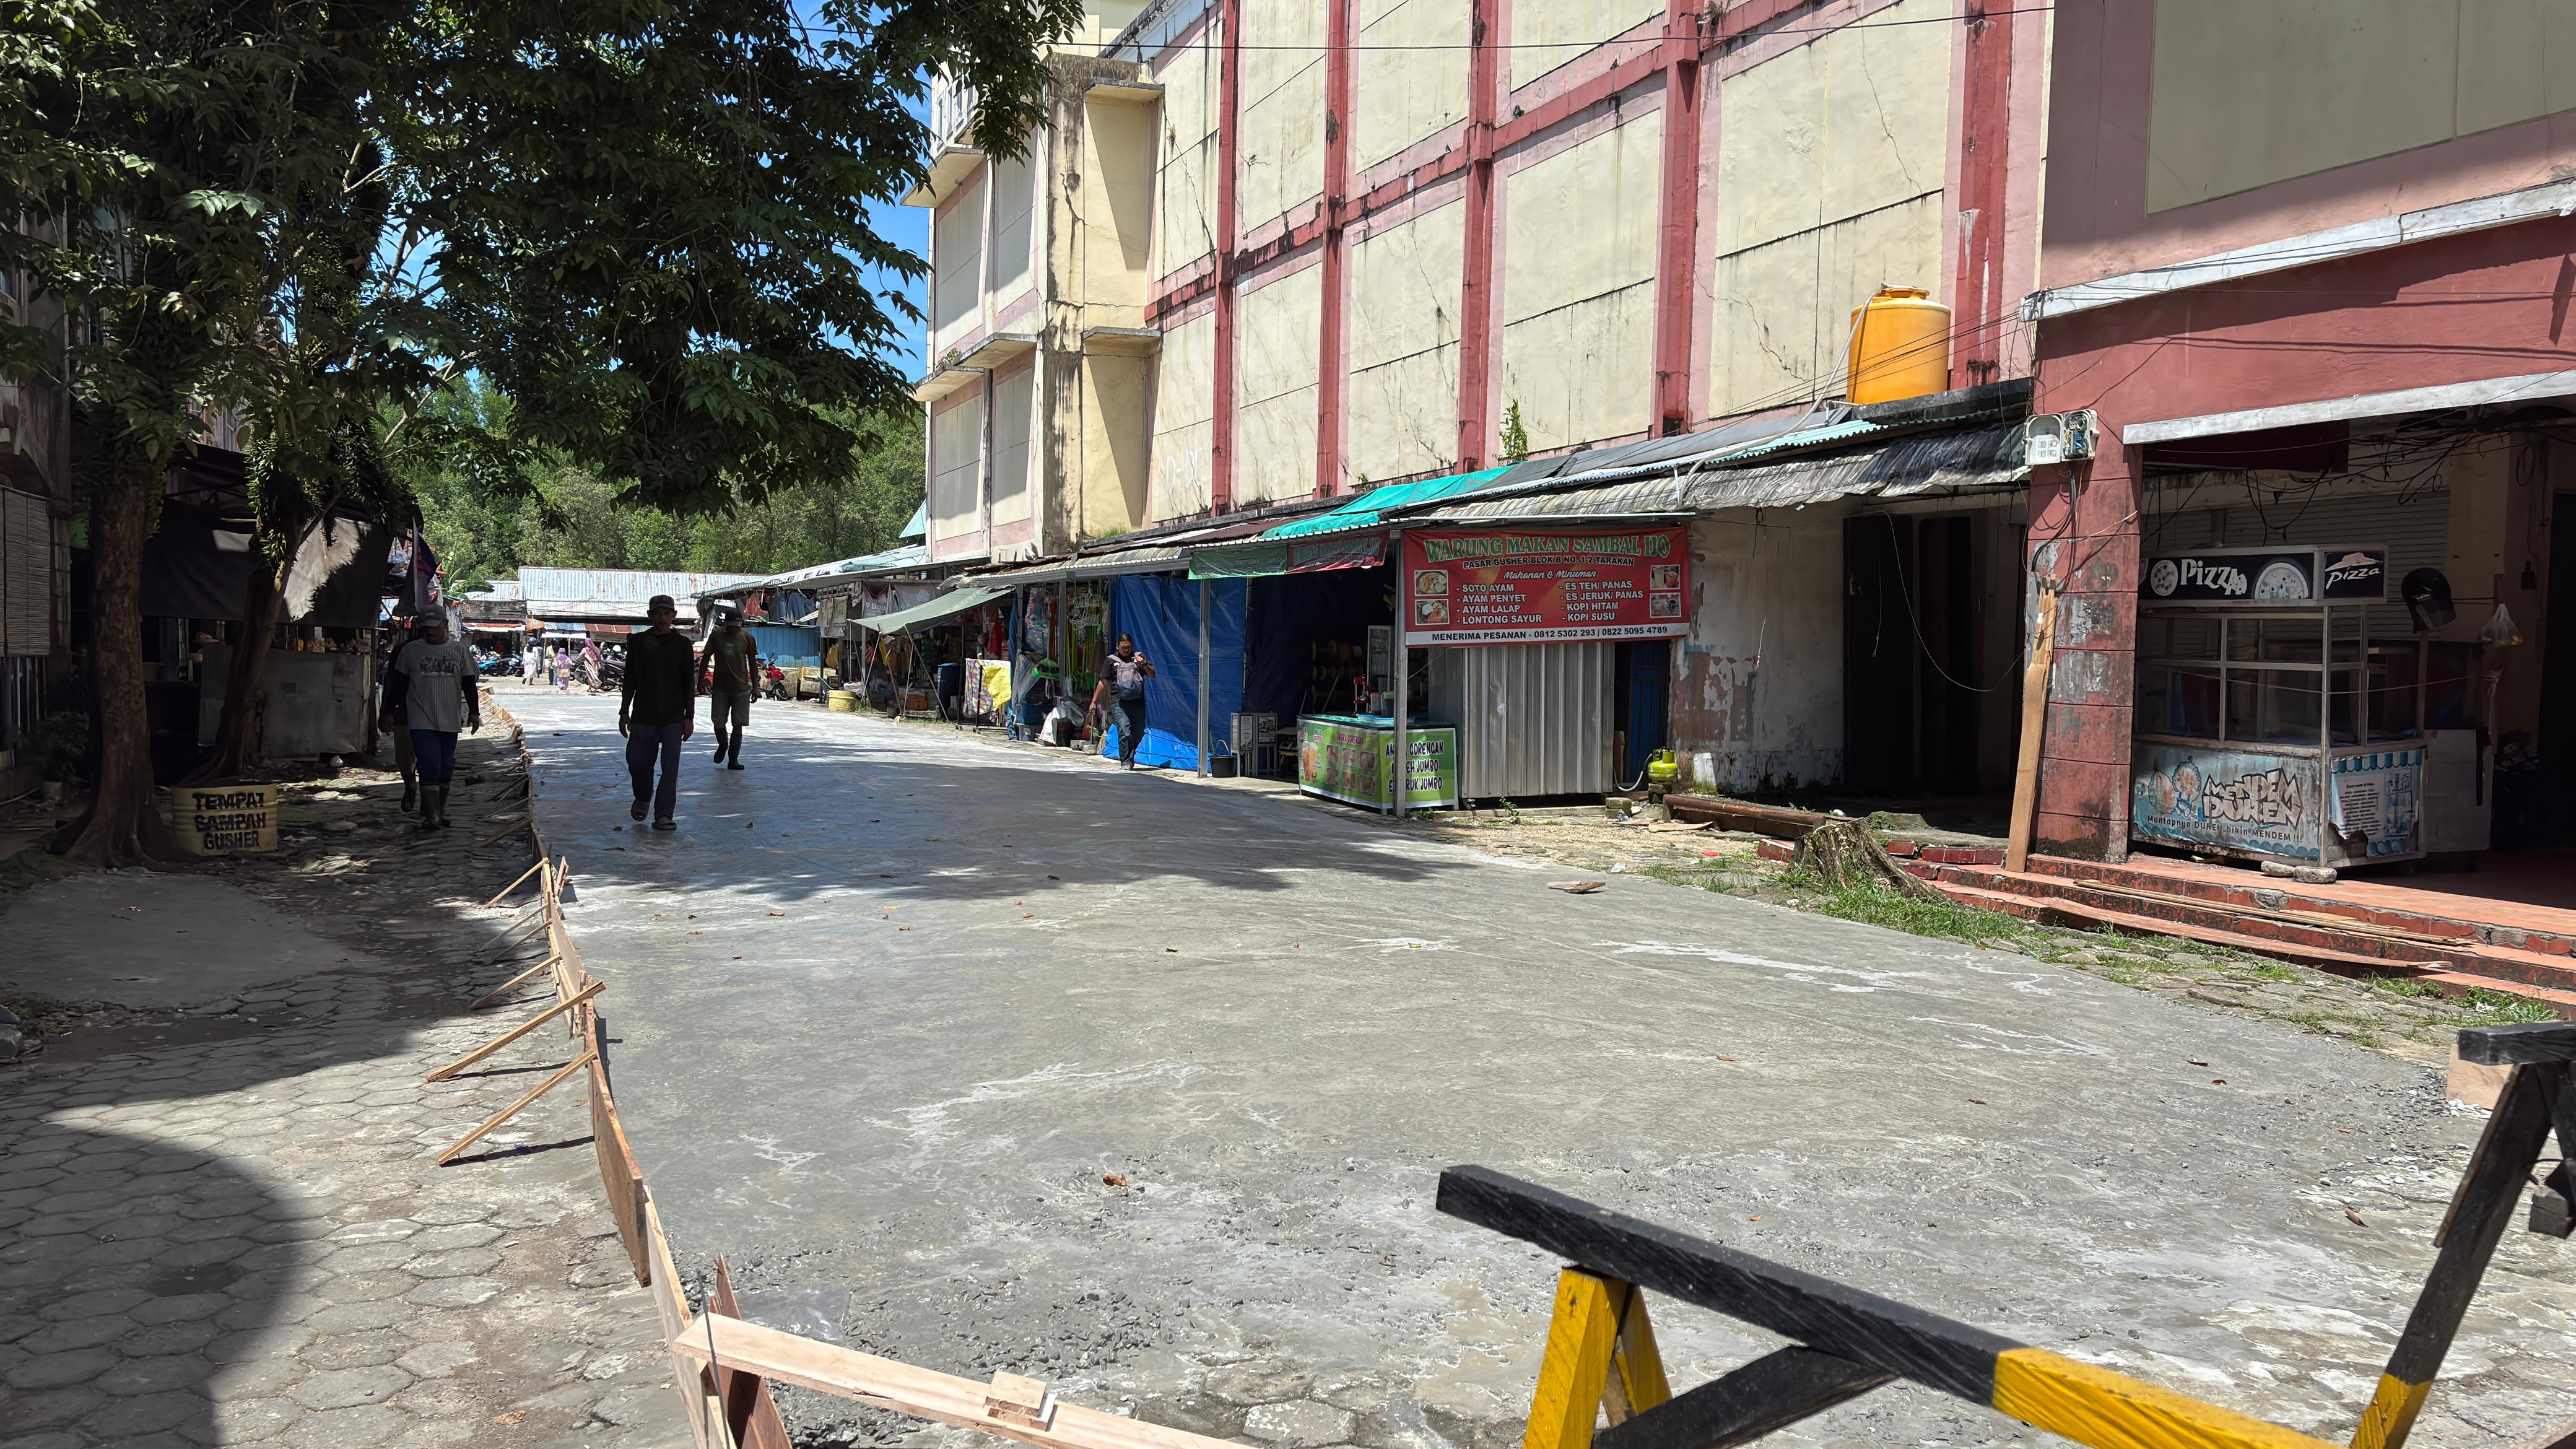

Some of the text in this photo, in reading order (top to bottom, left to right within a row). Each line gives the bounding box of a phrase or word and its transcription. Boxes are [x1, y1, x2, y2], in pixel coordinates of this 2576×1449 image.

[1424, 535, 1671, 563] WARUNG MAKAN SAMBAL IJO
[1464, 560, 1492, 569] PASAR
[1494, 557, 1528, 566] GUSHER
[1595, 557, 1635, 566] TARAKAN
[1503, 570, 1545, 579] Makanan
[1556, 570, 1596, 578] Minuman
[1462, 585, 1486, 593] SOTO
[1489, 584, 1514, 592] AYAM
[1603, 580, 1632, 588] PANAS
[1463, 595, 1488, 603] AYAM
[1490, 594, 1526, 603] PENYET
[1565, 593, 1578, 601] ES
[1616, 591, 1643, 599] PANAS
[1463, 606, 1488, 614] AYAM
[1491, 605, 1520, 613] LALAP
[1567, 603, 1588, 611] KOPI
[1591, 602, 1619, 610] HITAM
[1463, 616, 1508, 624] LONTONG
[1511, 614, 1542, 623] SAYUR
[1567, 614, 1588, 622] KOPI
[1591, 612, 1615, 620] SUSU
[1432, 632, 1481, 641] MENERIMA
[1484, 631, 1526, 639] PESANAN
[1602, 628, 1622, 636] 0822
[1647, 626, 1668, 634] 4789
[1409, 741, 1443, 755] GORENGAN
[1406, 760, 1415, 773] EH
[1416, 759, 1438, 773] JUMBO
[1406, 777, 1419, 791] RUK
[1421, 776, 1443, 791] JUMBO
[192, 793, 264, 810] TEMPAT
[194, 812, 266, 832] SAMPAH
[2147, 816, 2191, 829] Mantapnya
[2195, 821, 2222, 832] DUREN
[2227, 825, 2248, 835] bikin
[2252, 829, 2291, 841] MENDEM
[204, 830, 259, 850] GUSHER
